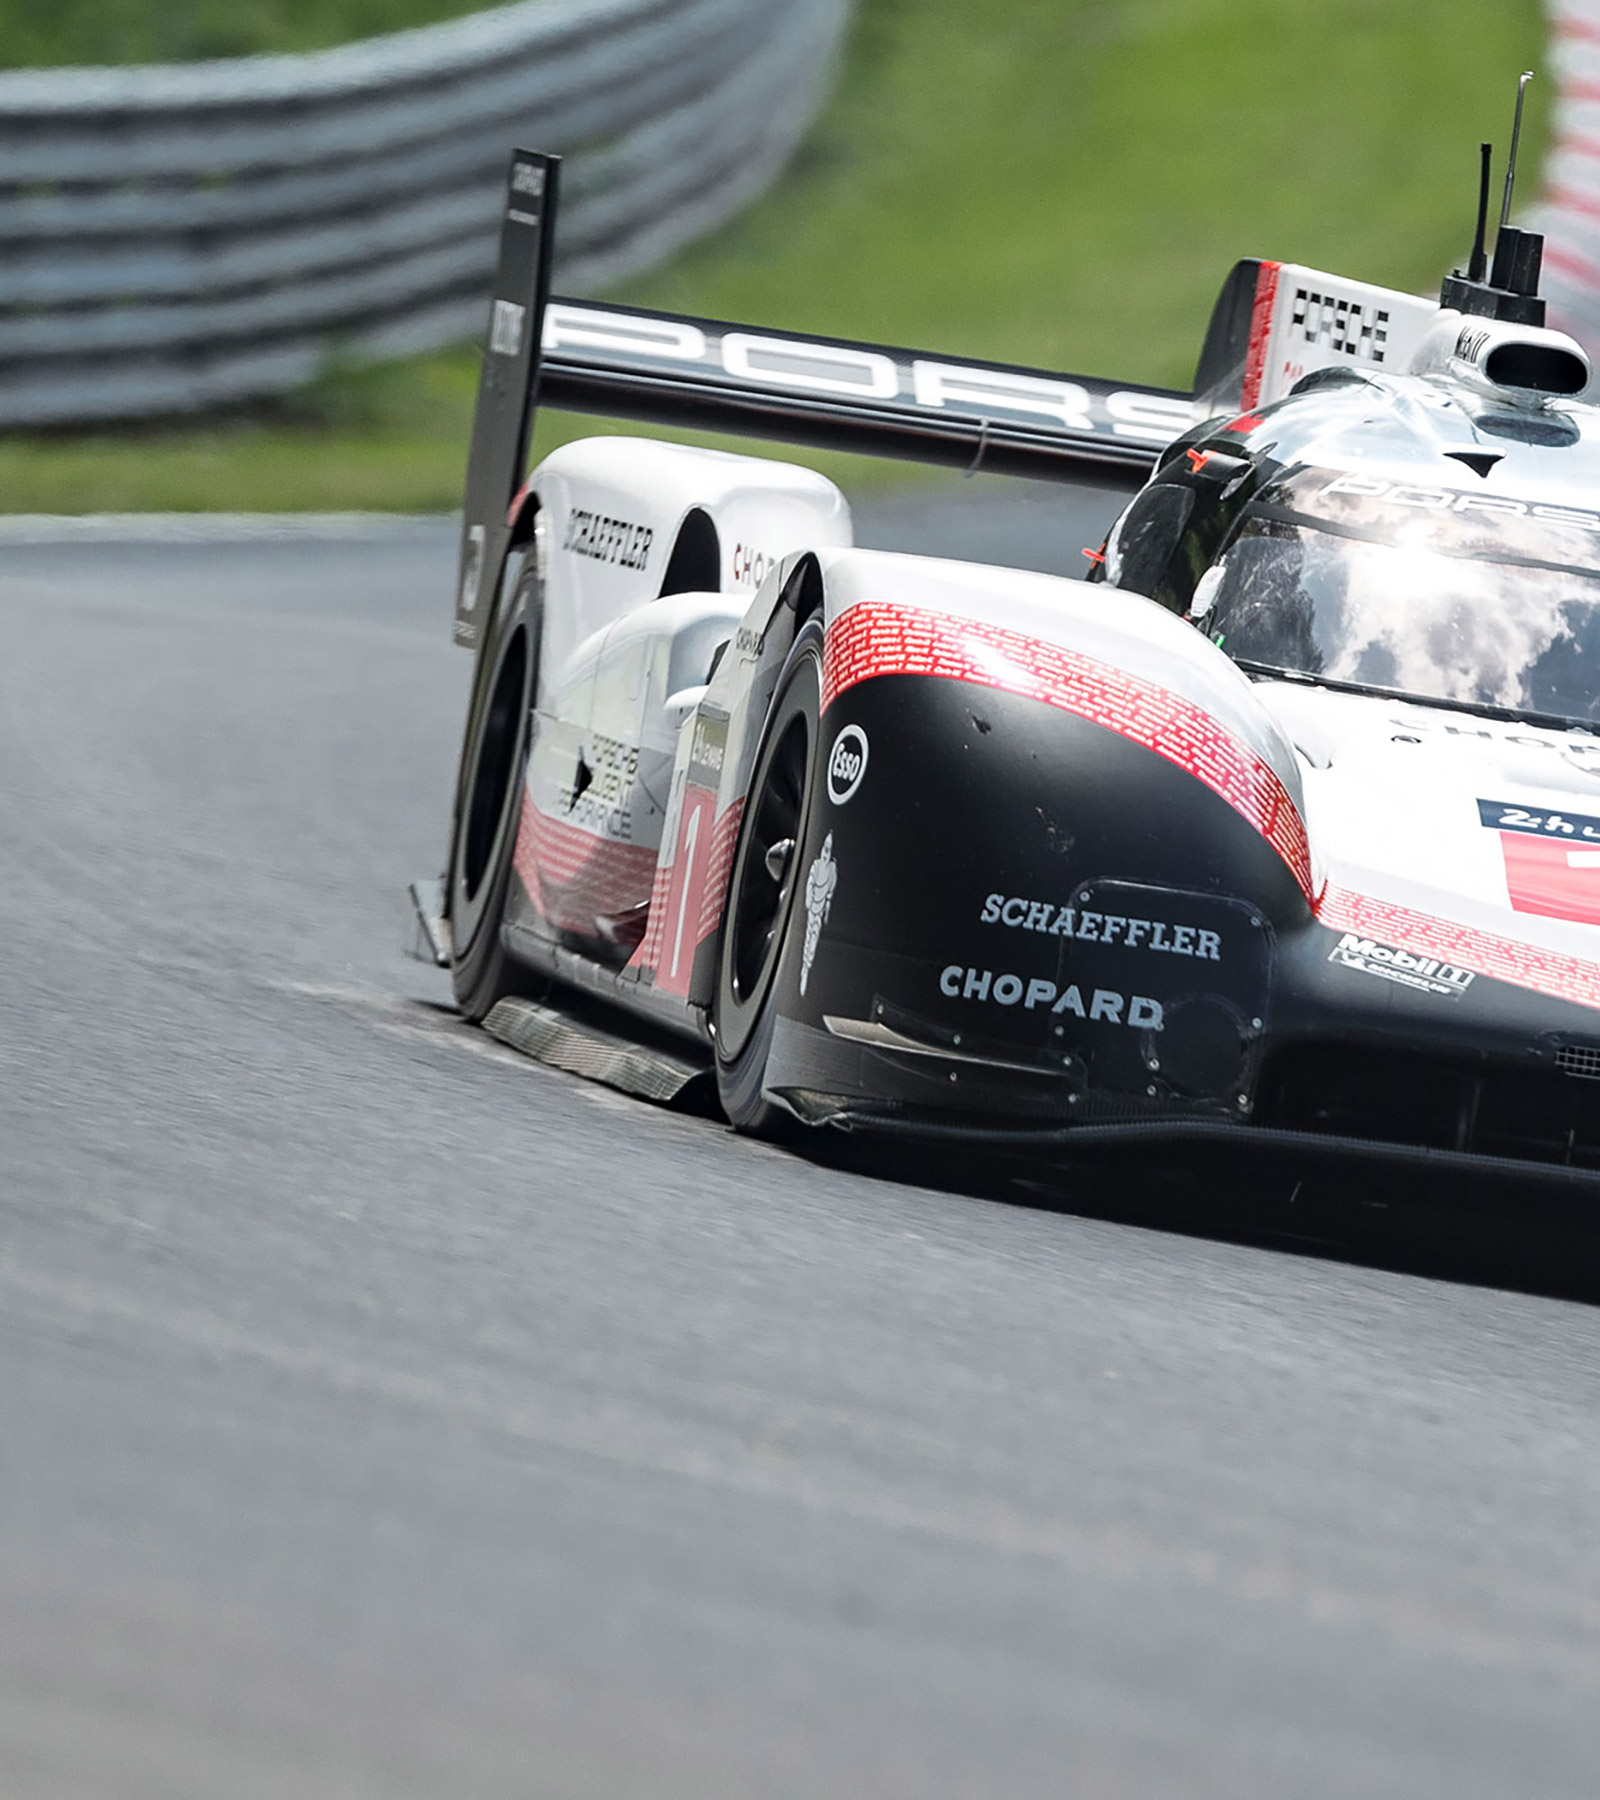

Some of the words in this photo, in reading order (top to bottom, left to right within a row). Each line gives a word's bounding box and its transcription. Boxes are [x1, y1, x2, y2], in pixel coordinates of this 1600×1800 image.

[1290, 288, 1389, 363] PORSCHE
[541, 303, 1196, 443] PORS
[833, 742, 860, 781] Esso
[980, 893, 1223, 961] SCHAEFFLER
[1338, 934, 1440, 977] Mobil
[939, 965, 1165, 1030] CHOPARD
